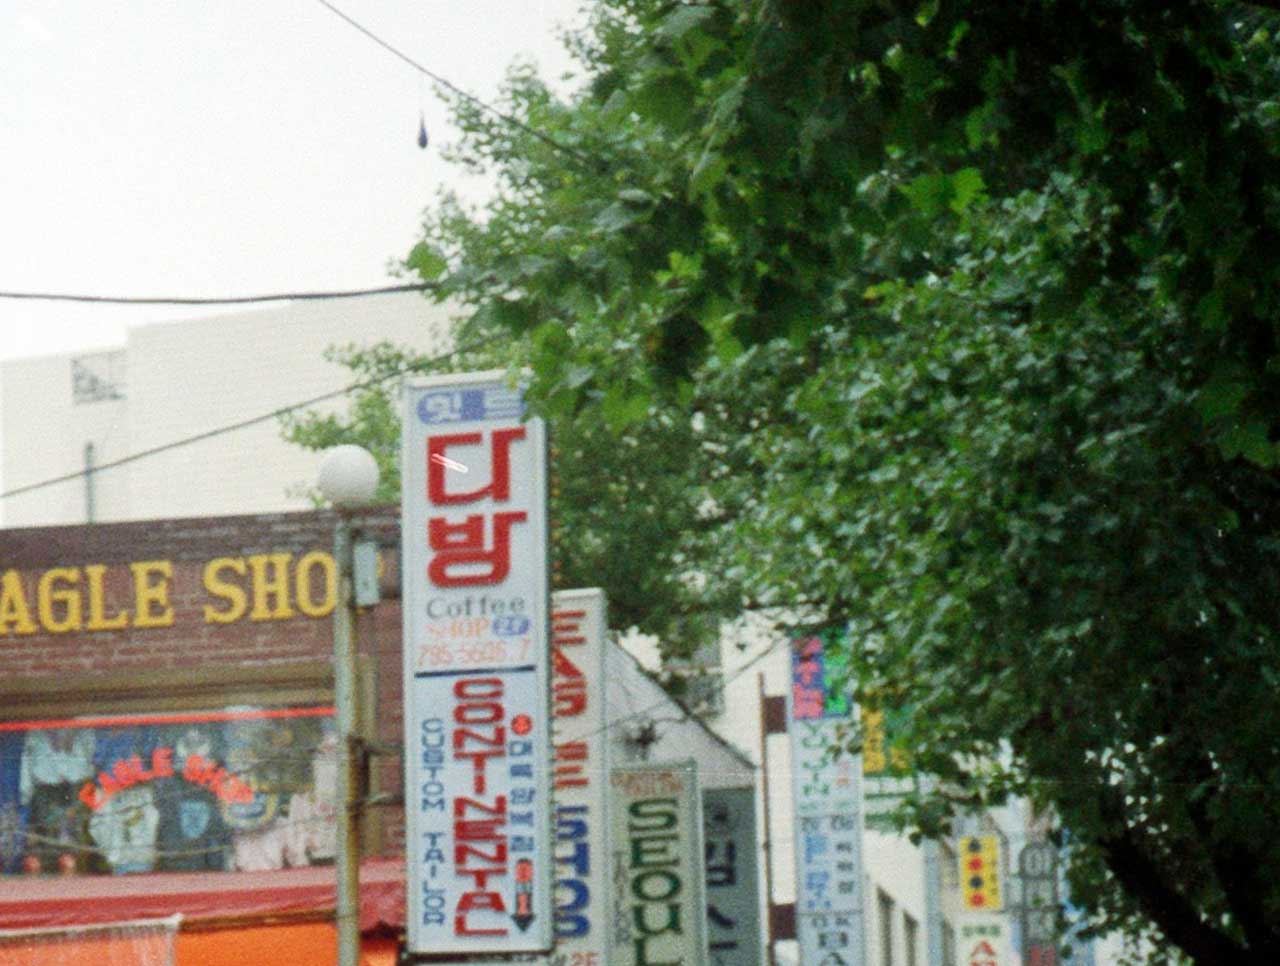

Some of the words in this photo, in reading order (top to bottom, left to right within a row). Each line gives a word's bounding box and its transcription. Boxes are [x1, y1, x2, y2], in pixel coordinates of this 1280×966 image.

[426, 426, 528, 590] 다방
[203, 550, 385, 625] SHO
[426, 597, 525, 620] Coffee
[422, 718, 445, 812] CUSTOM
[452, 677, 508, 937] CONTINENTAL
[422, 833, 446, 926] TAILOR
